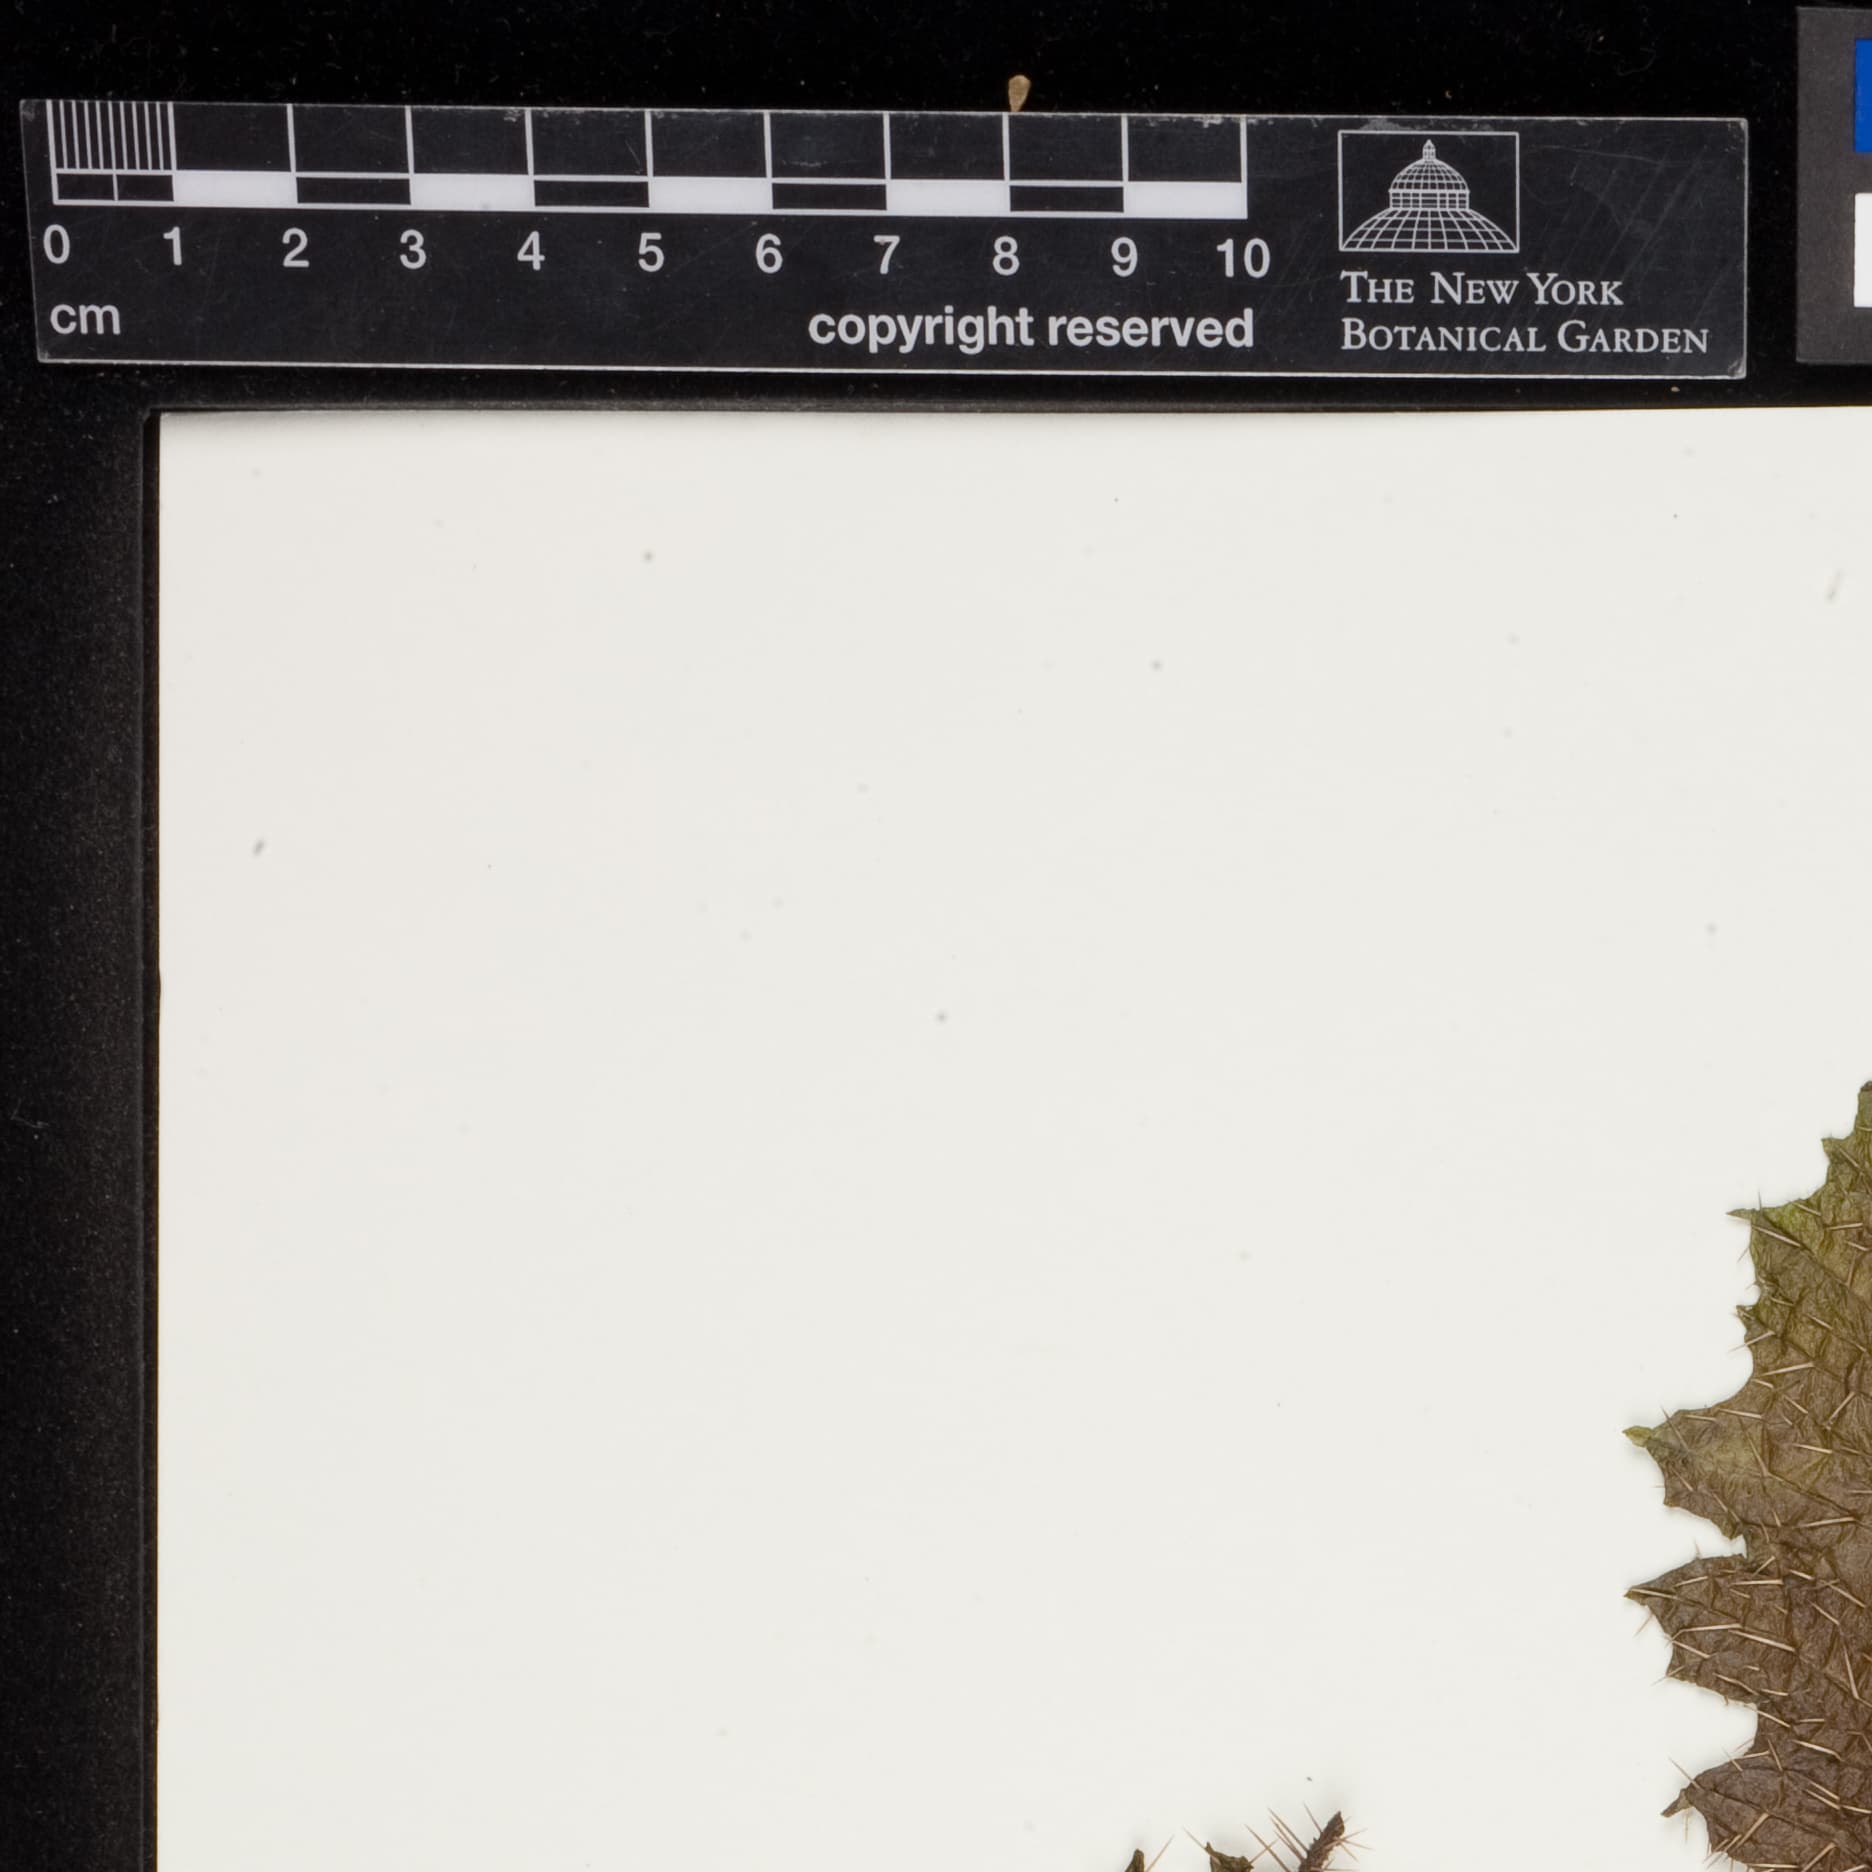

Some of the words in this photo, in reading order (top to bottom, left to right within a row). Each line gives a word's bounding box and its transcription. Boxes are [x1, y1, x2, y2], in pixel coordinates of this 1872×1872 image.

[43, 224, 70, 264] 0
[163, 226, 182, 266] 1
[282, 227, 310, 267] 2
[400, 229, 427, 269] 3
[517, 230, 545, 271] 4
[638, 232, 665, 272] 5
[755, 233, 783, 274] 6
[873, 235, 900, 275] 7
[992, 235, 1020, 276] 8
[1111, 236, 1138, 277] 9
[1216, 237, 1271, 278] 10
[1339, 269, 1415, 304] THE
[1430, 271, 1520, 305] NEW
[1526, 272, 1624, 306] YORK
[50, 304, 121, 335] cm
[808, 305, 1035, 355] copyright
[1048, 307, 1254, 348] reserved
[1341, 317, 1547, 352] BOTANICAL
[1557, 319, 1709, 354] GARDEN
